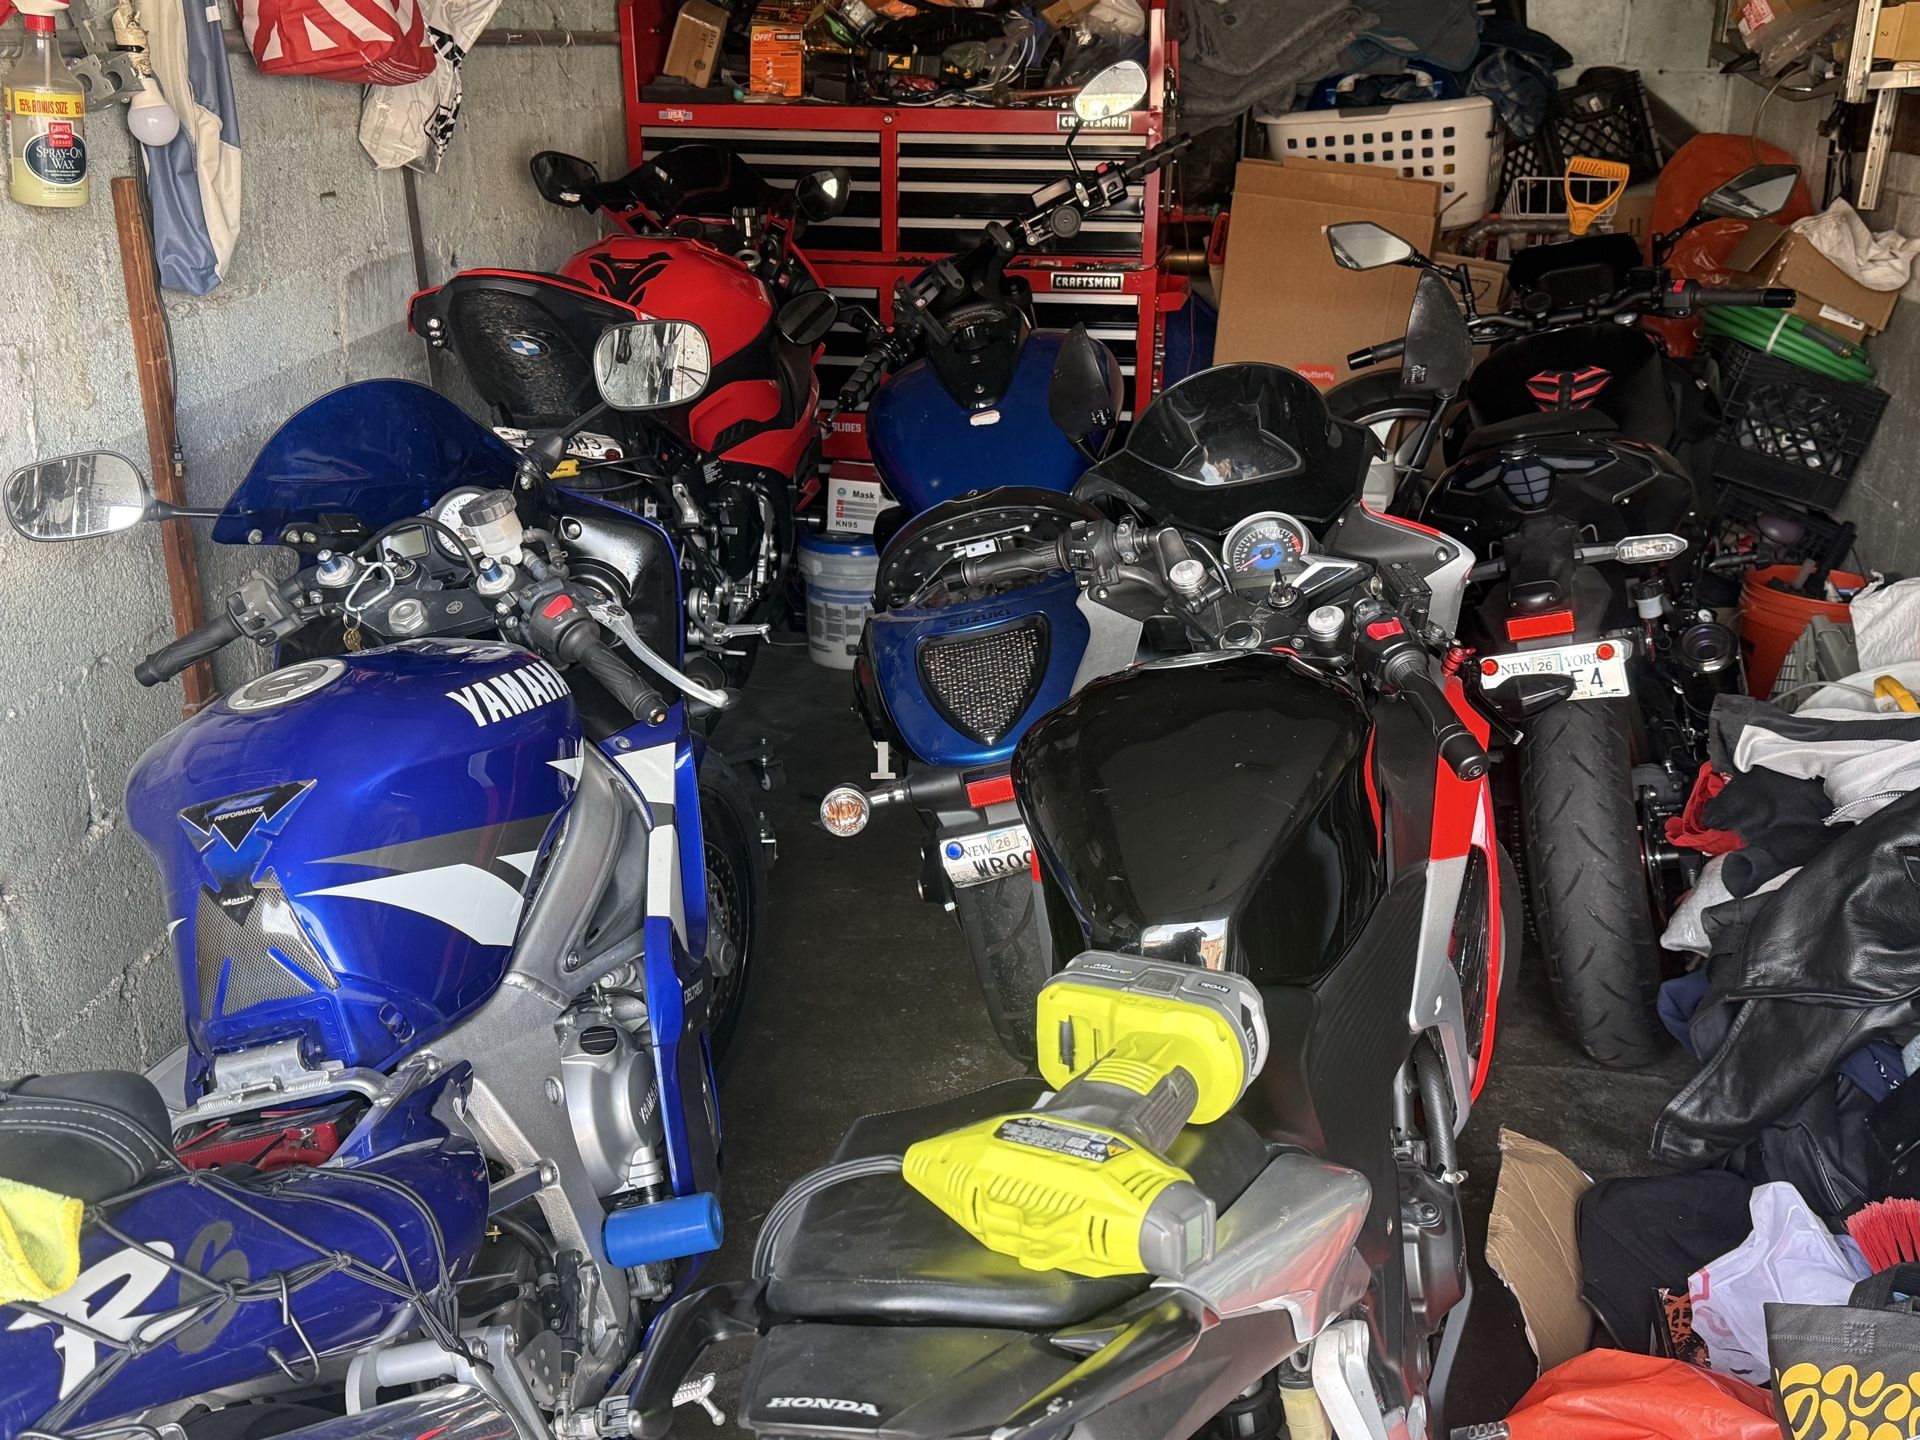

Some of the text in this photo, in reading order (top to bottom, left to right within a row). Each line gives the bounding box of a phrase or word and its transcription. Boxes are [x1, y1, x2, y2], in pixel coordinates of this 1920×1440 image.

[753, 33, 772, 41] OFF!
[19, 98, 31, 112] 15%
[32, 99, 55, 114] BONUS
[55, 101, 68, 114] SIZE
[51, 157, 75, 170] WAX
[1055, 277, 1119, 288] CRAFTSMAN
[831, 422, 862, 433] SLIDES
[852, 490, 875, 500] Mask
[835, 520, 858, 529] KN95
[949, 608, 1011, 627] SUZUKI
[1501, 661, 1532, 676] NEW
[1538, 661, 1553, 672] 26
[445, 660, 572, 727] YAMAHA
[214, 805, 264, 822] PERFORMANCE
[996, 837, 1011, 849] 26
[962, 843, 992, 859] NEW
[1200, 981, 1229, 993] RYOBI
[766, 1397, 880, 1417] HONDA
